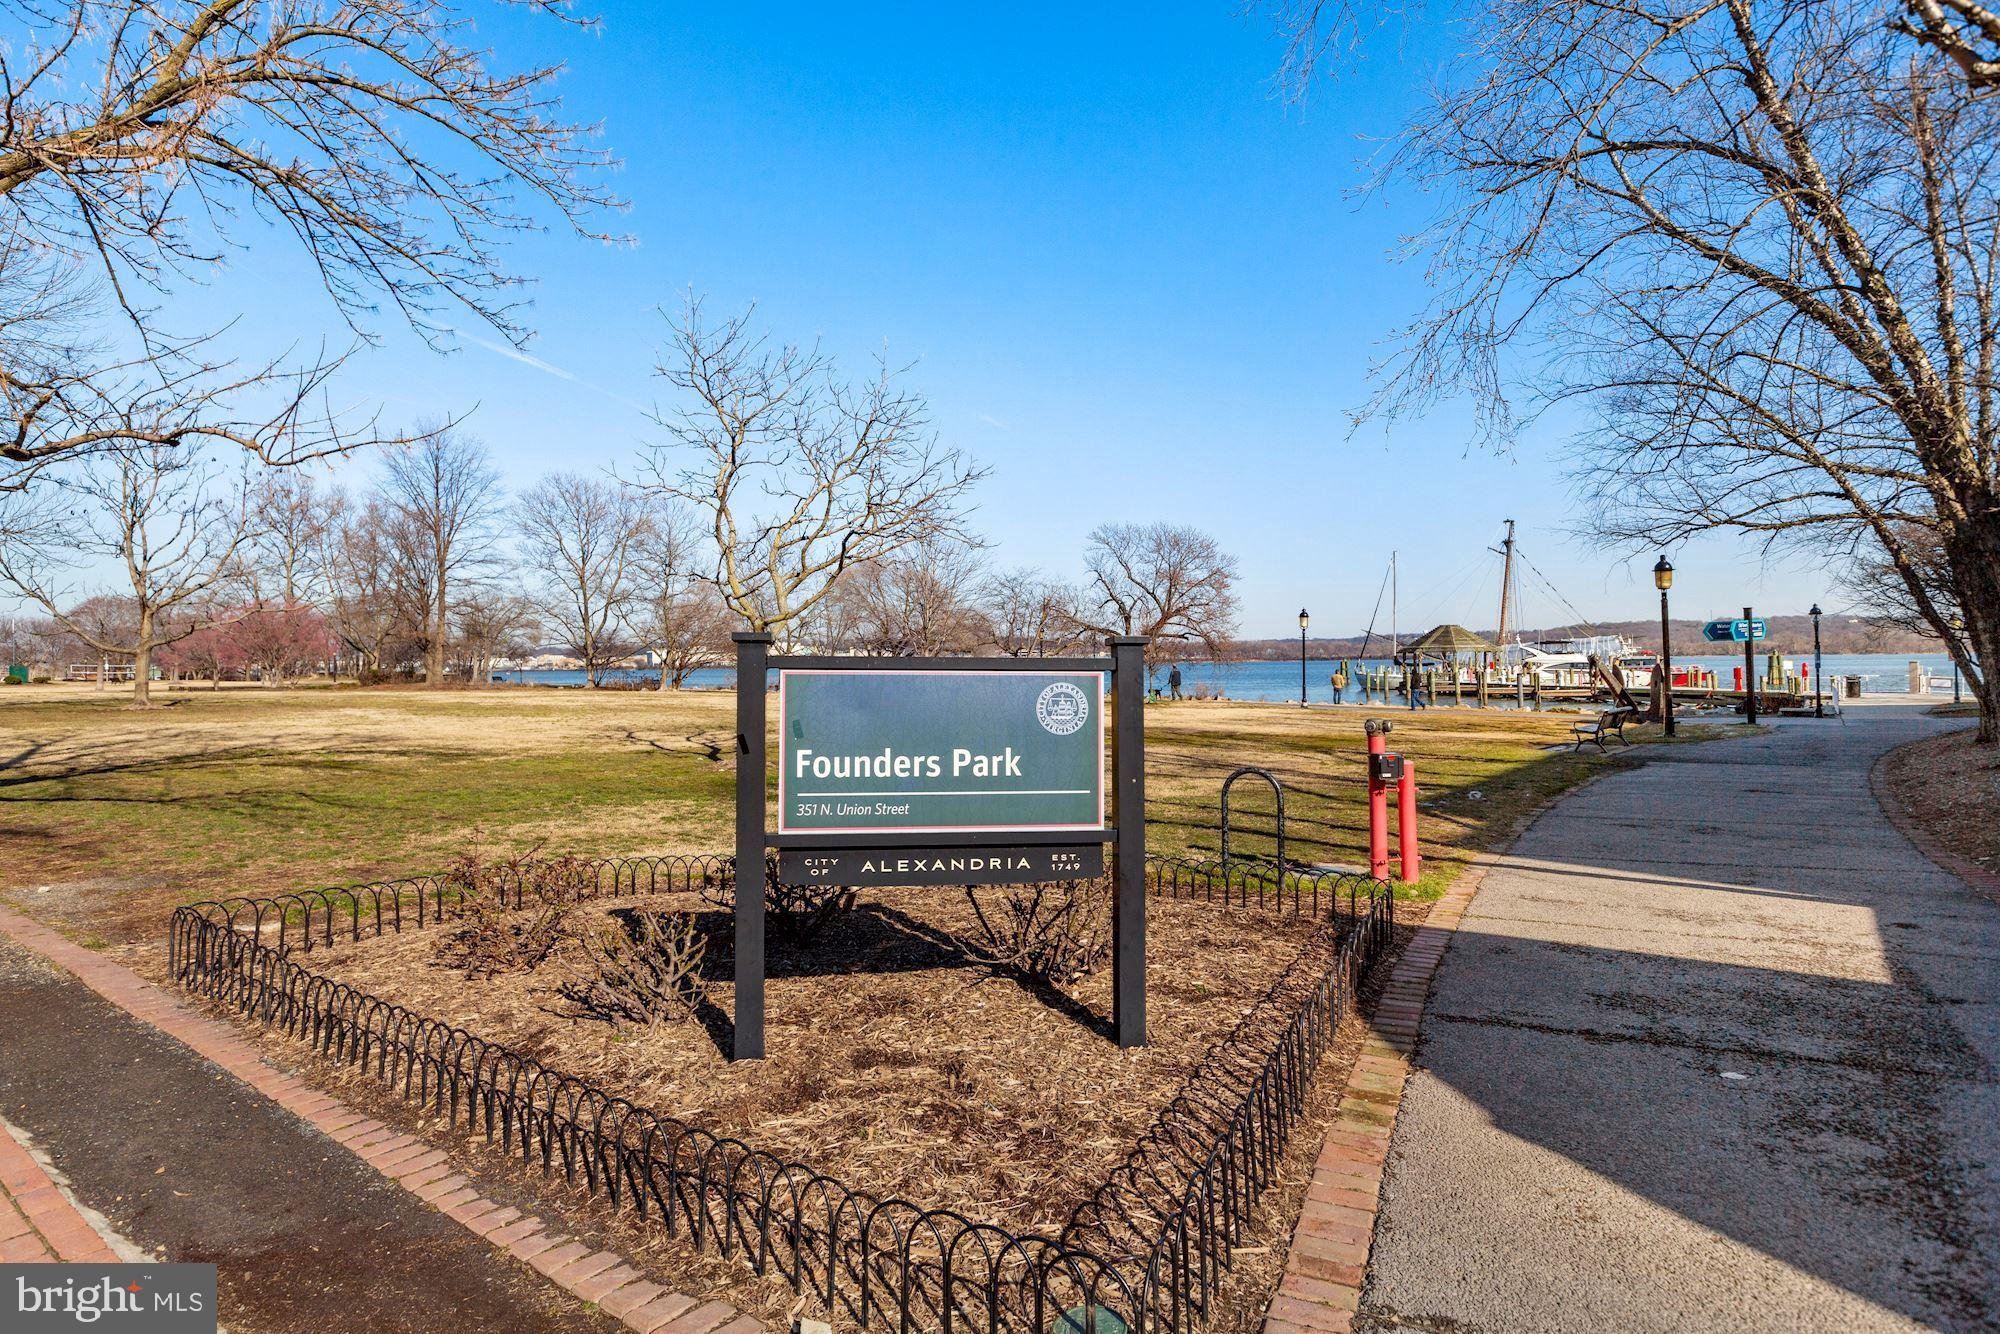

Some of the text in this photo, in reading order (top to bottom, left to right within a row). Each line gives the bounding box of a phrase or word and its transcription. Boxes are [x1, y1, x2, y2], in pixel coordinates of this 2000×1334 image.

[796, 747, 1022, 778] Founders Park
[796, 802, 910, 816] 351 N. Union Street
[1051, 853, 1081, 861] EST.
[804, 858, 839, 867] CITY
[861, 857, 1031, 873] ALEXANDRIA
[1051, 862, 1081, 871] 1749
[810, 868, 829, 876] OF
